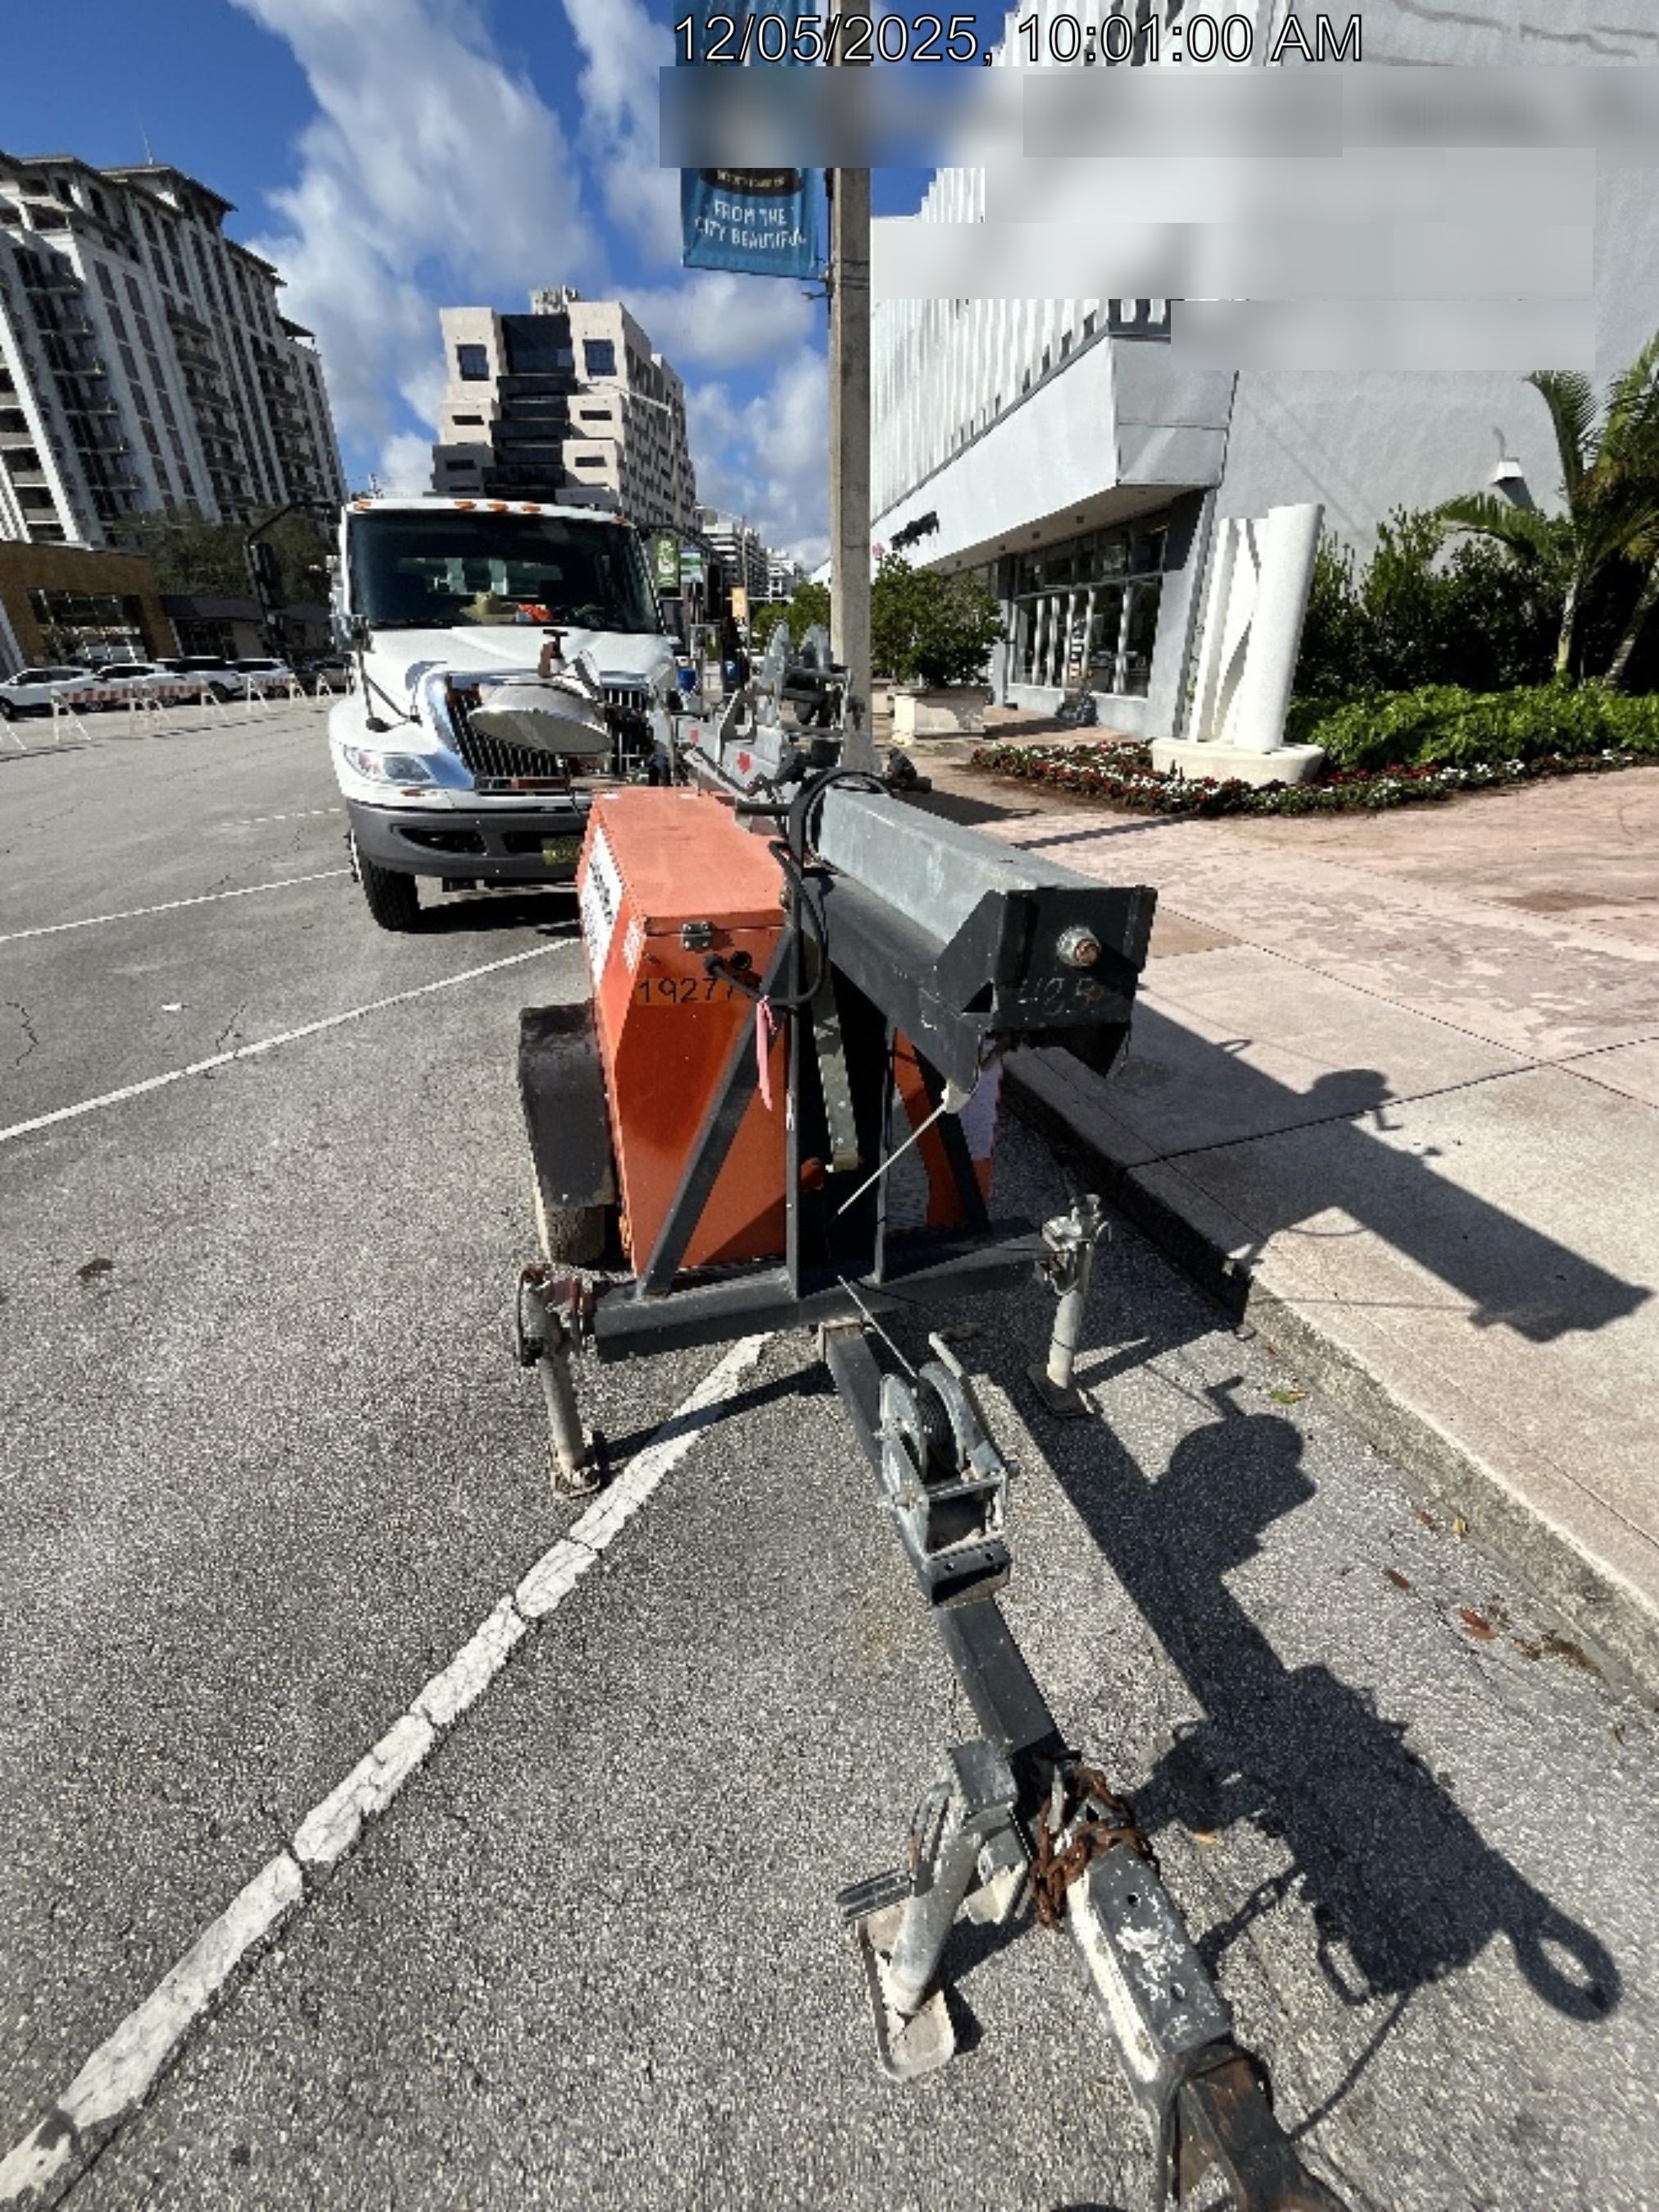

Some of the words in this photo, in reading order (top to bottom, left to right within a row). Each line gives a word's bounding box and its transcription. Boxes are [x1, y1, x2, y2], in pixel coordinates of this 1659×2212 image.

[714, 198, 755, 226] FROM
[759, 207, 787, 227] THE
[695, 215, 726, 242] CITY
